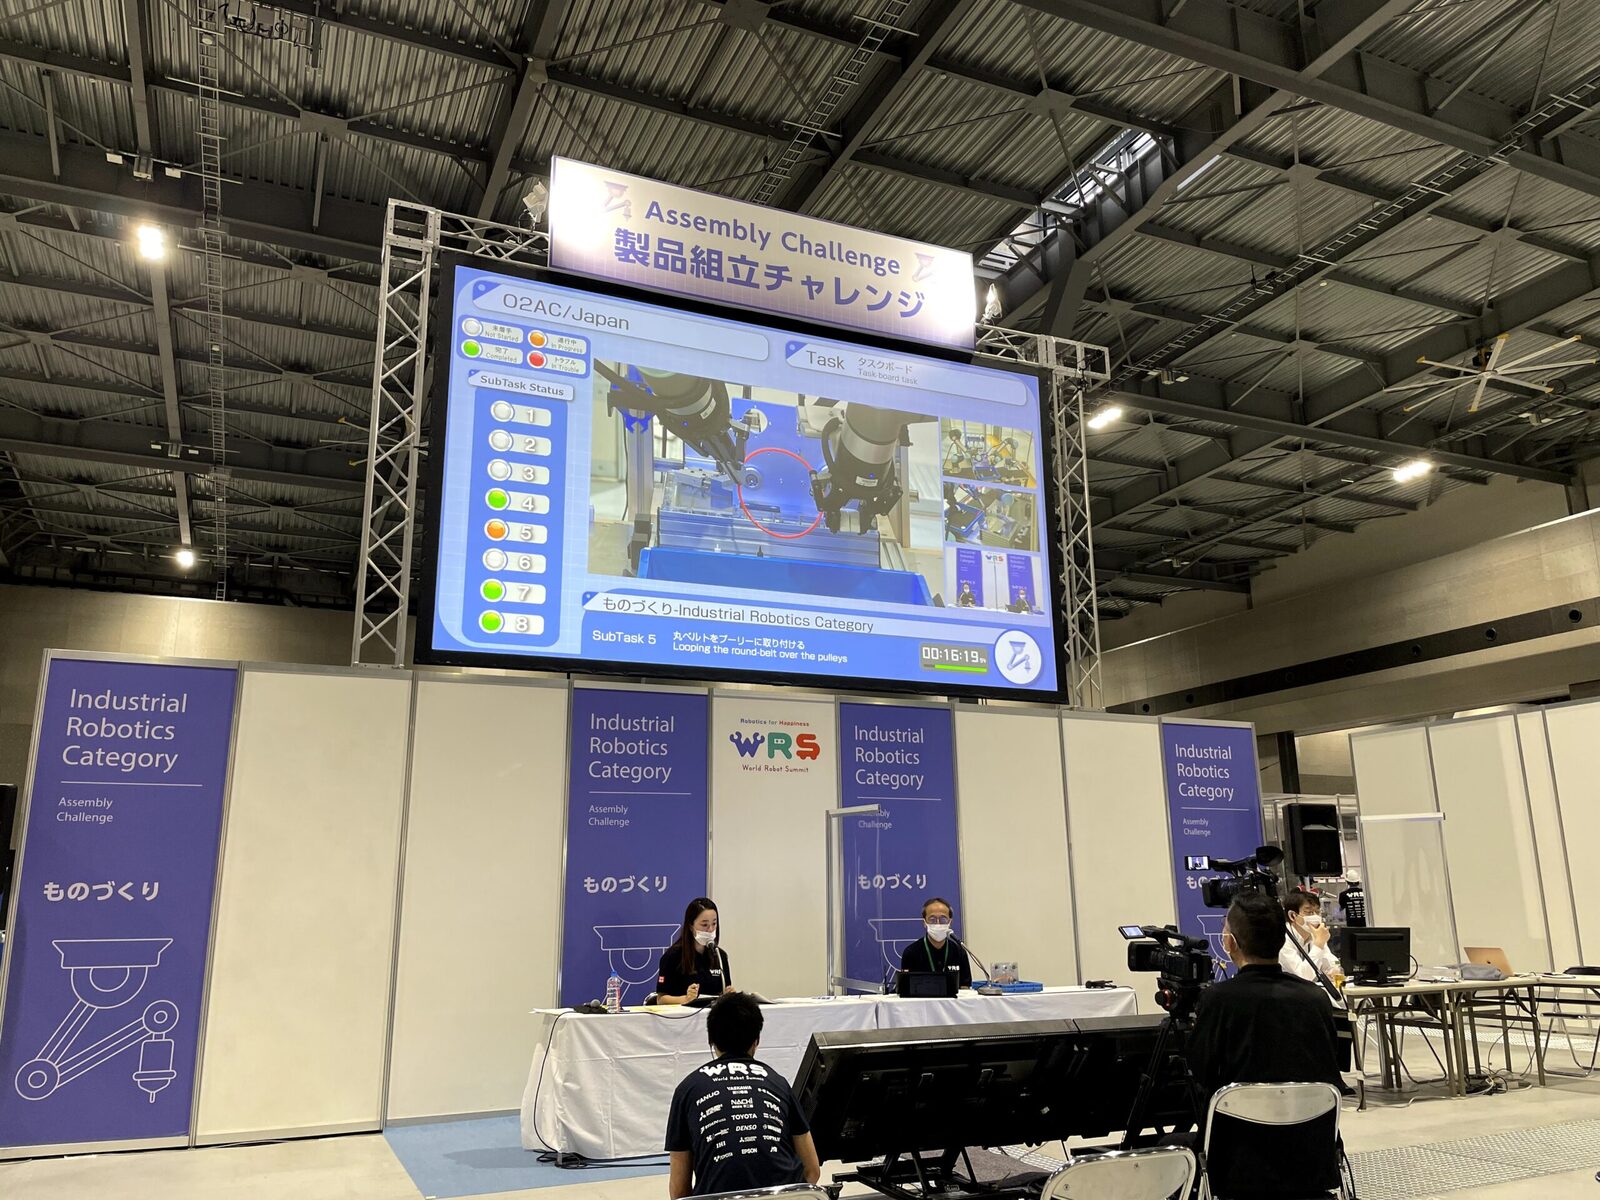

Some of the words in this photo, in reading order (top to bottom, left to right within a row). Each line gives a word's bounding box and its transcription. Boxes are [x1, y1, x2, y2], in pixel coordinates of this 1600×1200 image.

[645, 201, 771, 251] Assembly
[781, 231, 900, 277] Challenge
[614, 227, 925, 318] 製品組立チャレンジ
[486, 352, 517, 363] Completed
[806, 350, 845, 370] Task
[858, 356, 913, 375] タスクボード
[480, 375, 527, 390] SubTask
[529, 383, 564, 396] Status
[902, 377, 918, 385] task
[527, 409, 535, 423] 1
[525, 438, 536, 452] 2
[523, 467, 535, 481] 3
[522, 496, 534, 511] 4
[520, 526, 532, 541] 5
[519, 556, 531, 570] 6
[518, 586, 530, 601] 7
[516, 616, 528, 632] 8
[750, 610, 810, 627] Robotics
[815, 616, 874, 633] Category
[592, 630, 644, 645] SubTask
[648, 634, 656, 645] 5
[673, 641, 711, 655] Looping
[713, 645, 728, 654] the
[731, 647, 777, 658] round-belt
[779, 650, 798, 659] over
[801, 652, 815, 660] the
[818, 654, 848, 664] pulleys
[922, 647, 979, 663] 00:16:19
[70, 689, 188, 713] Industrial
[66, 717, 175, 740] Robotics
[590, 713, 675, 732] Industrial
[854, 725, 924, 744] Industrial
[589, 737, 668, 756] Robotics
[729, 731, 820, 760] WRS
[1175, 743, 1232, 760] Industrial
[62, 745, 178, 773] Category
[855, 747, 920, 765] Robotics
[588, 761, 672, 784] Category
[742, 764, 761, 772] World
[764, 764, 782, 773] Robot
[785, 765, 809, 773] Summit
[1177, 763, 1230, 779] Robotics
[855, 769, 924, 790] Category
[1178, 782, 1234, 801] Category
[58, 797, 113, 810] Assembly
[589, 805, 628, 815] Assembly
[56, 812, 114, 825] Challenge
[588, 818, 630, 828] Challenge
[858, 820, 892, 830] Challenge
[1183, 818, 1209, 827] Assembly
[1183, 828, 1211, 837] Challenge
[583, 875, 668, 893] ものづくり
[858, 874, 927, 890] ものづくり
[43, 880, 159, 902] ものづくり
[699, 1063, 768, 1077] WRS
[731, 1097, 754, 1105] NACHI
[735, 1124, 757, 1132] DENSO
[741, 1147, 758, 1155] EPSON
